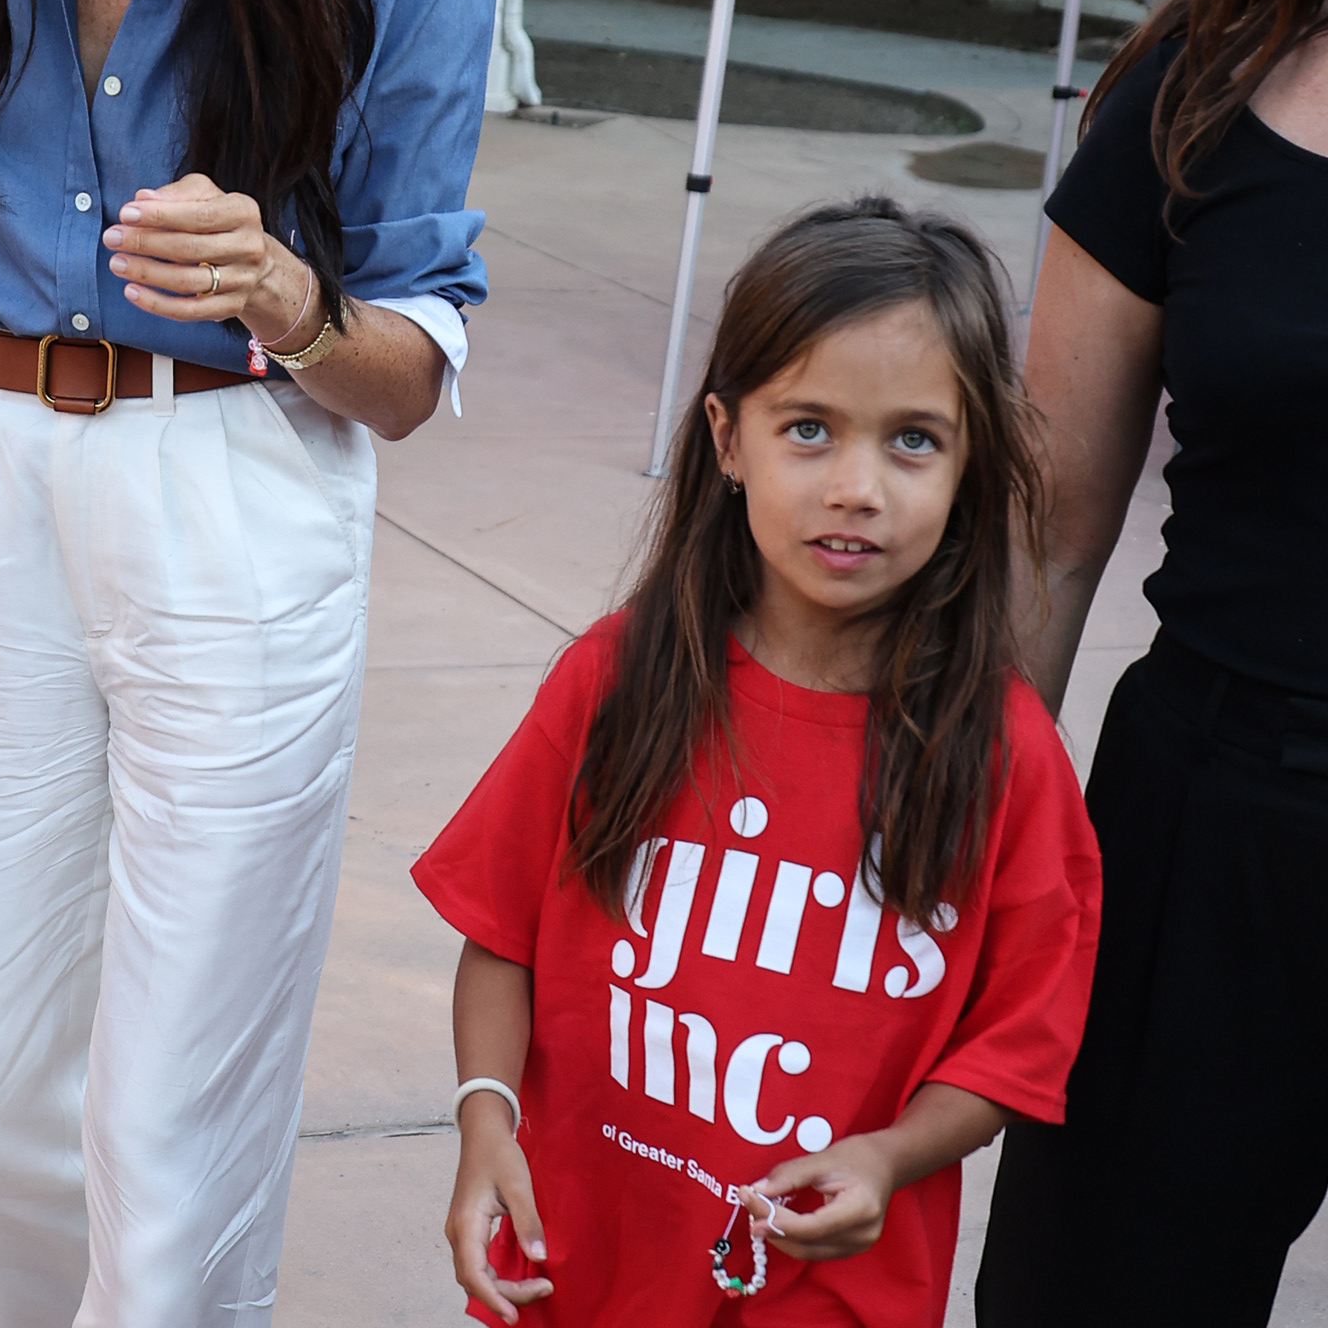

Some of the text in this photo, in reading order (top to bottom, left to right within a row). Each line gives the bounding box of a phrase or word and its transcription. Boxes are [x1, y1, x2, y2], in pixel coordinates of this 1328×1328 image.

[610, 795, 959, 1000] girls
[608, 982, 834, 1154] inc.
[618, 1131, 685, 1173] Greater
[686, 1158, 723, 1199] Santa
